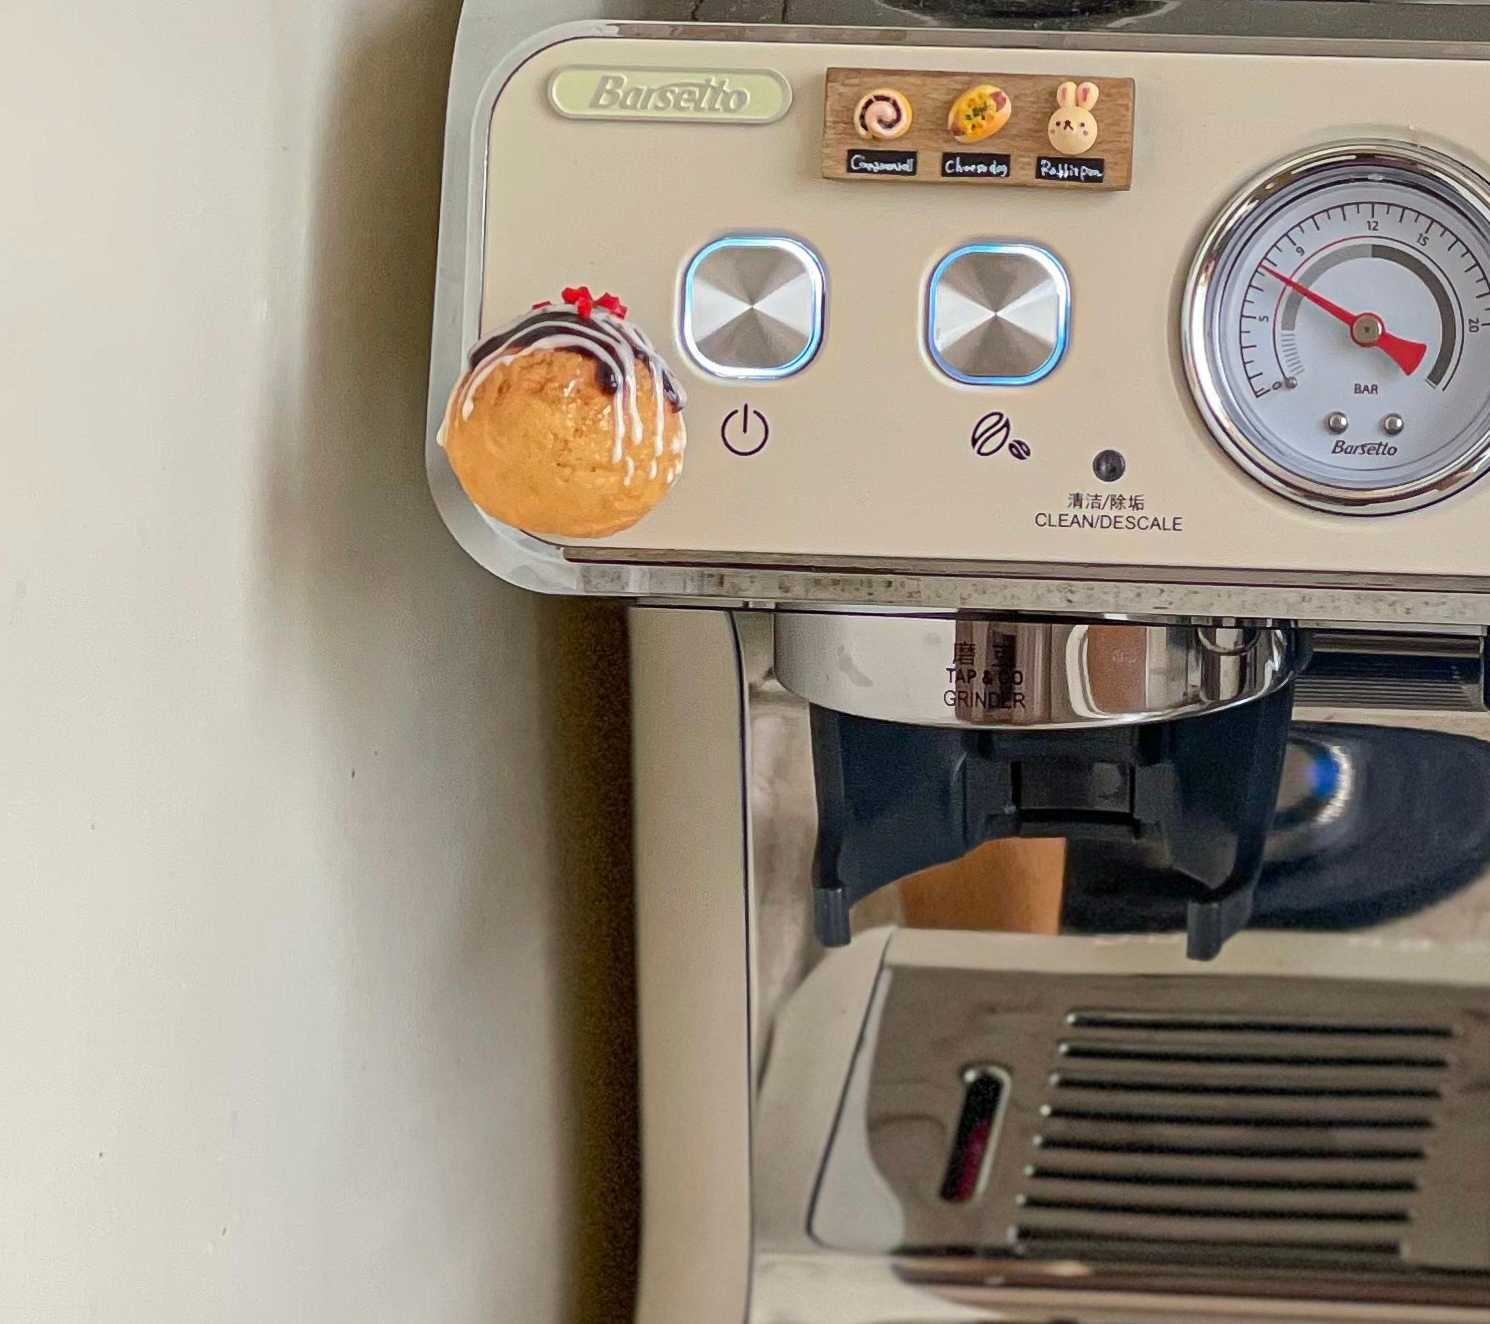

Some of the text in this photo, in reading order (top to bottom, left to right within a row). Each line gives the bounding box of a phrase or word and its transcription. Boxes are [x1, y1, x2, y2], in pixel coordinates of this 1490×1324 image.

[589, 75, 751, 113] Barsetto
[1366, 220, 1379, 232] 12
[1416, 232, 1430, 248] 15
[1295, 246, 1306, 257] 9
[1258, 314, 1269, 323] 5
[1467, 317, 1480, 334] 20
[1354, 383, 1379, 395] BAR
[1331, 440, 1398, 457] Barsetto
[1067, 492, 1146, 511] 清洁/除垢
[1034, 512, 1184, 532] CLEAN/DESCALE
[946, 667, 977, 685] TAP
[943, 689, 1026, 709] GRINDER
